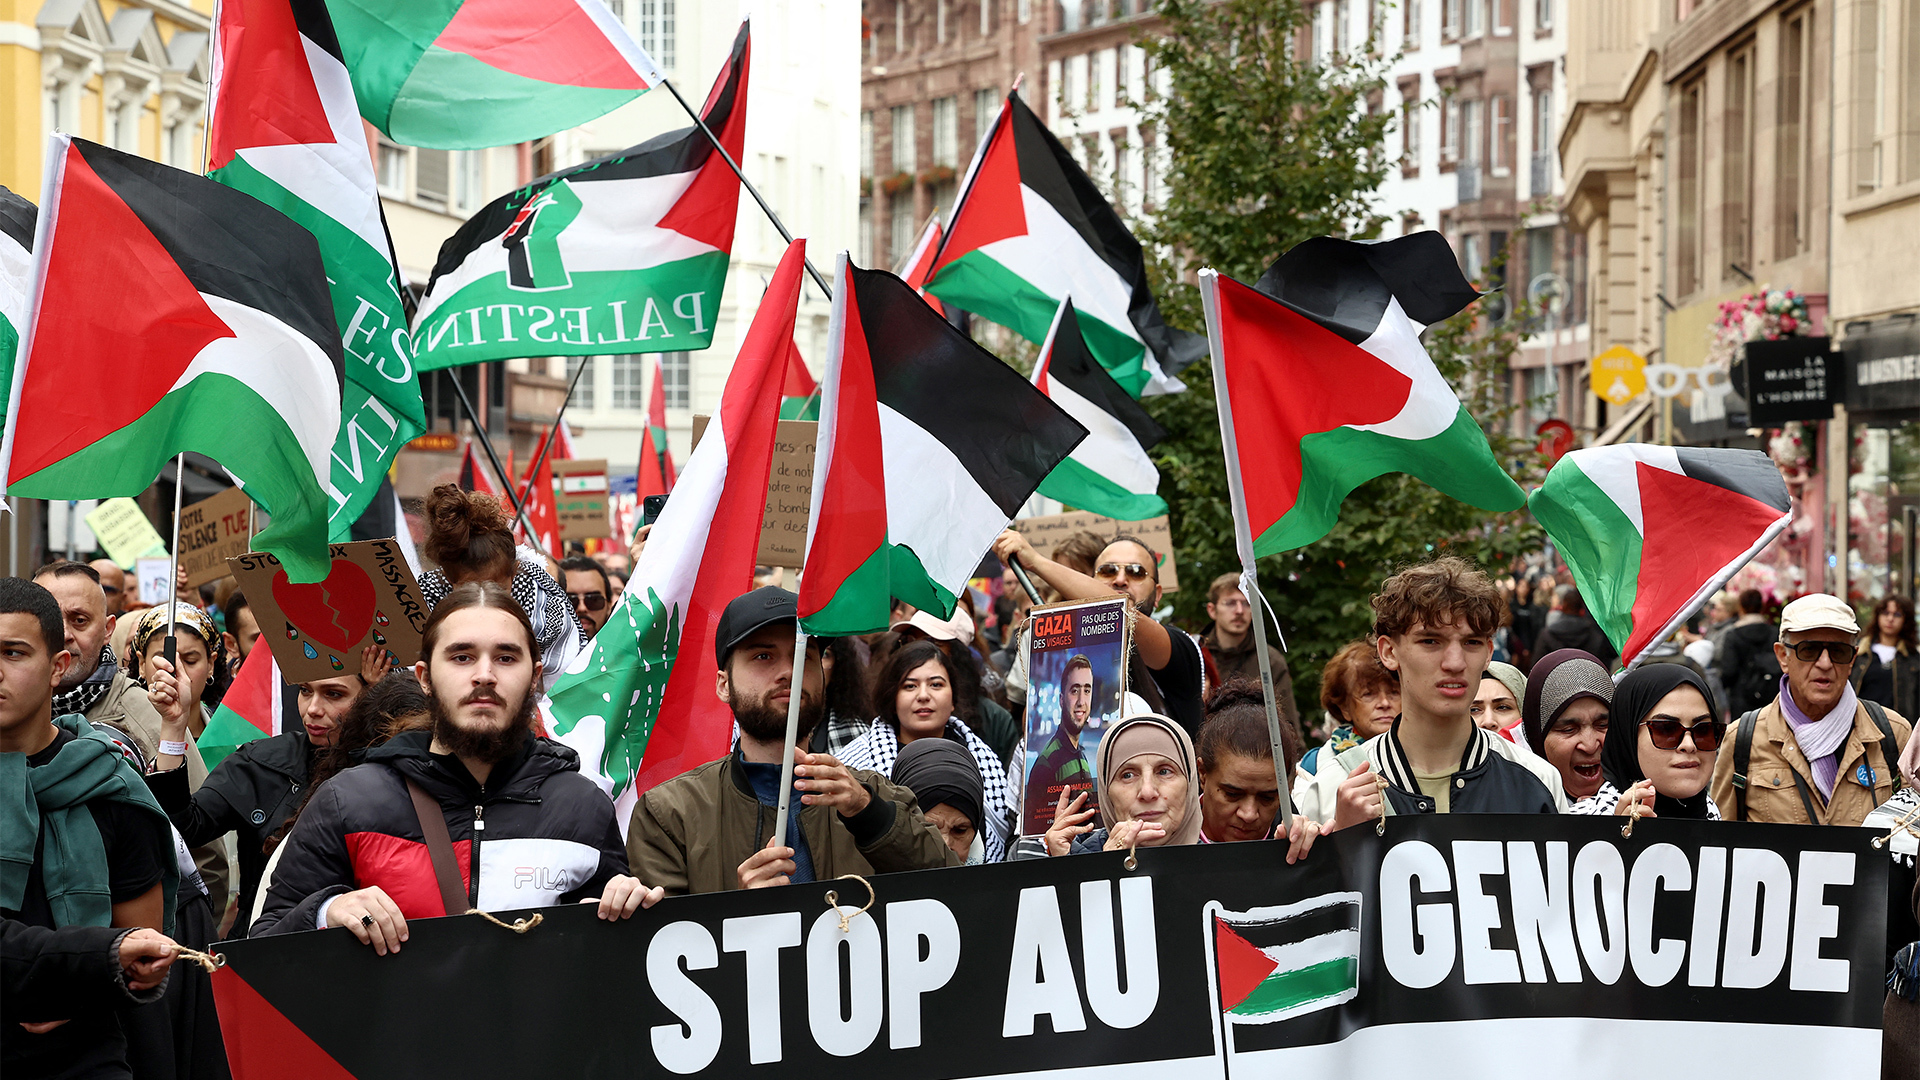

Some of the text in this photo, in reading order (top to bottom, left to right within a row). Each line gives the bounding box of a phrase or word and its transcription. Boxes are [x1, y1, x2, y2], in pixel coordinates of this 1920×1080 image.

[1804, 356, 1825, 367] LA
[1764, 367, 1826, 381] MAISON
[1805, 378, 1826, 390] DE
[1757, 390, 1826, 405] L'HOMME
[777, 462, 790, 476] de
[222, 509, 248, 537] TUE
[179, 521, 218, 554] SILENCE
[239, 552, 287, 571] STO
[371, 541, 426, 635] MASSACRES
[1034, 613, 1073, 637] GAZA
[1081, 611, 1119, 624] PAS QUE DES
[1080, 622, 1115, 637] NOMBRES
[1033, 635, 1073, 650] DES VISAGES
[513, 866, 569, 892] FILA
[646, 840, 1857, 1075] STOP AU GENOCIDE
